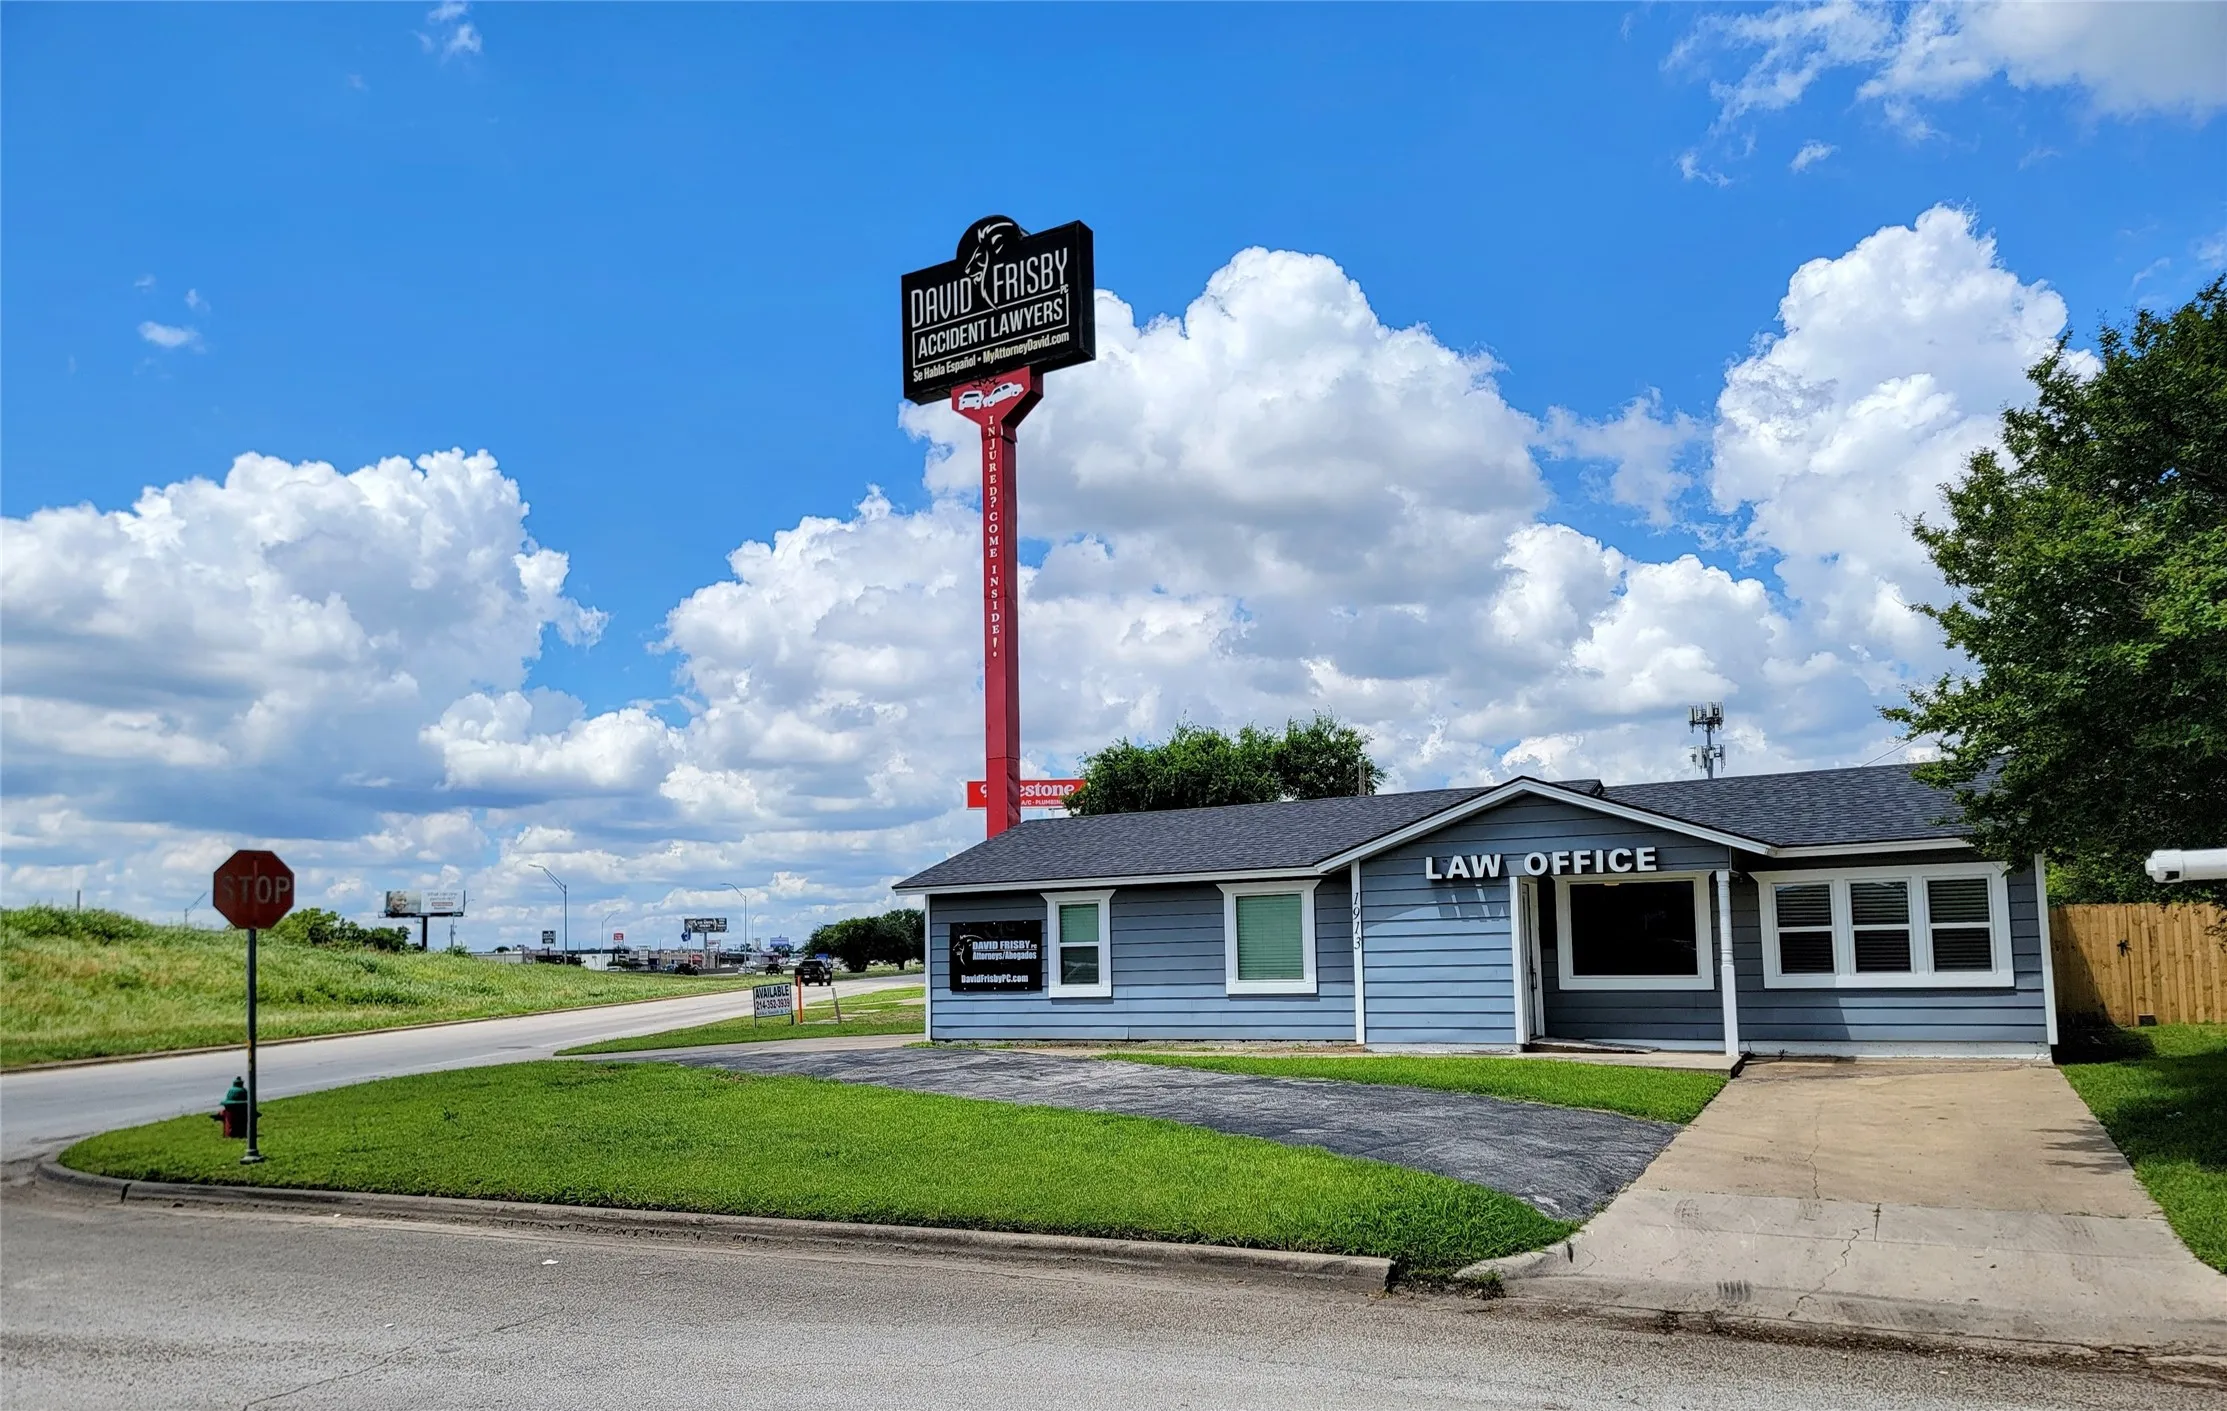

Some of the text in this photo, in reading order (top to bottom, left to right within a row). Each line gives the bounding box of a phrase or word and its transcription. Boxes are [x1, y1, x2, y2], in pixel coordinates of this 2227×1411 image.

[911, 248, 1068, 328] DAVID FRISBY
[1060, 284, 1069, 295] PC
[918, 298, 1063, 359] ACCIDENT LAWYERS
[913, 332, 1069, 382] Se Habla Español MyAttorneyDavid.com
[987, 415, 997, 508] INJURED?
[989, 511, 998, 558] COME
[1425, 847, 1658, 880] LAW OFFICE
[223, 875, 291, 904] STOP
[1352, 892, 1362, 950] 1913
[972, 941, 998, 950] DAVID
[1000, 940, 1031, 949] FRISBY
[973, 951, 1037, 960] Attorneys/Abogados
[755, 985, 790, 999] AVAILABLE
[961, 974, 1029, 984] DavidFrisbyPC.com
